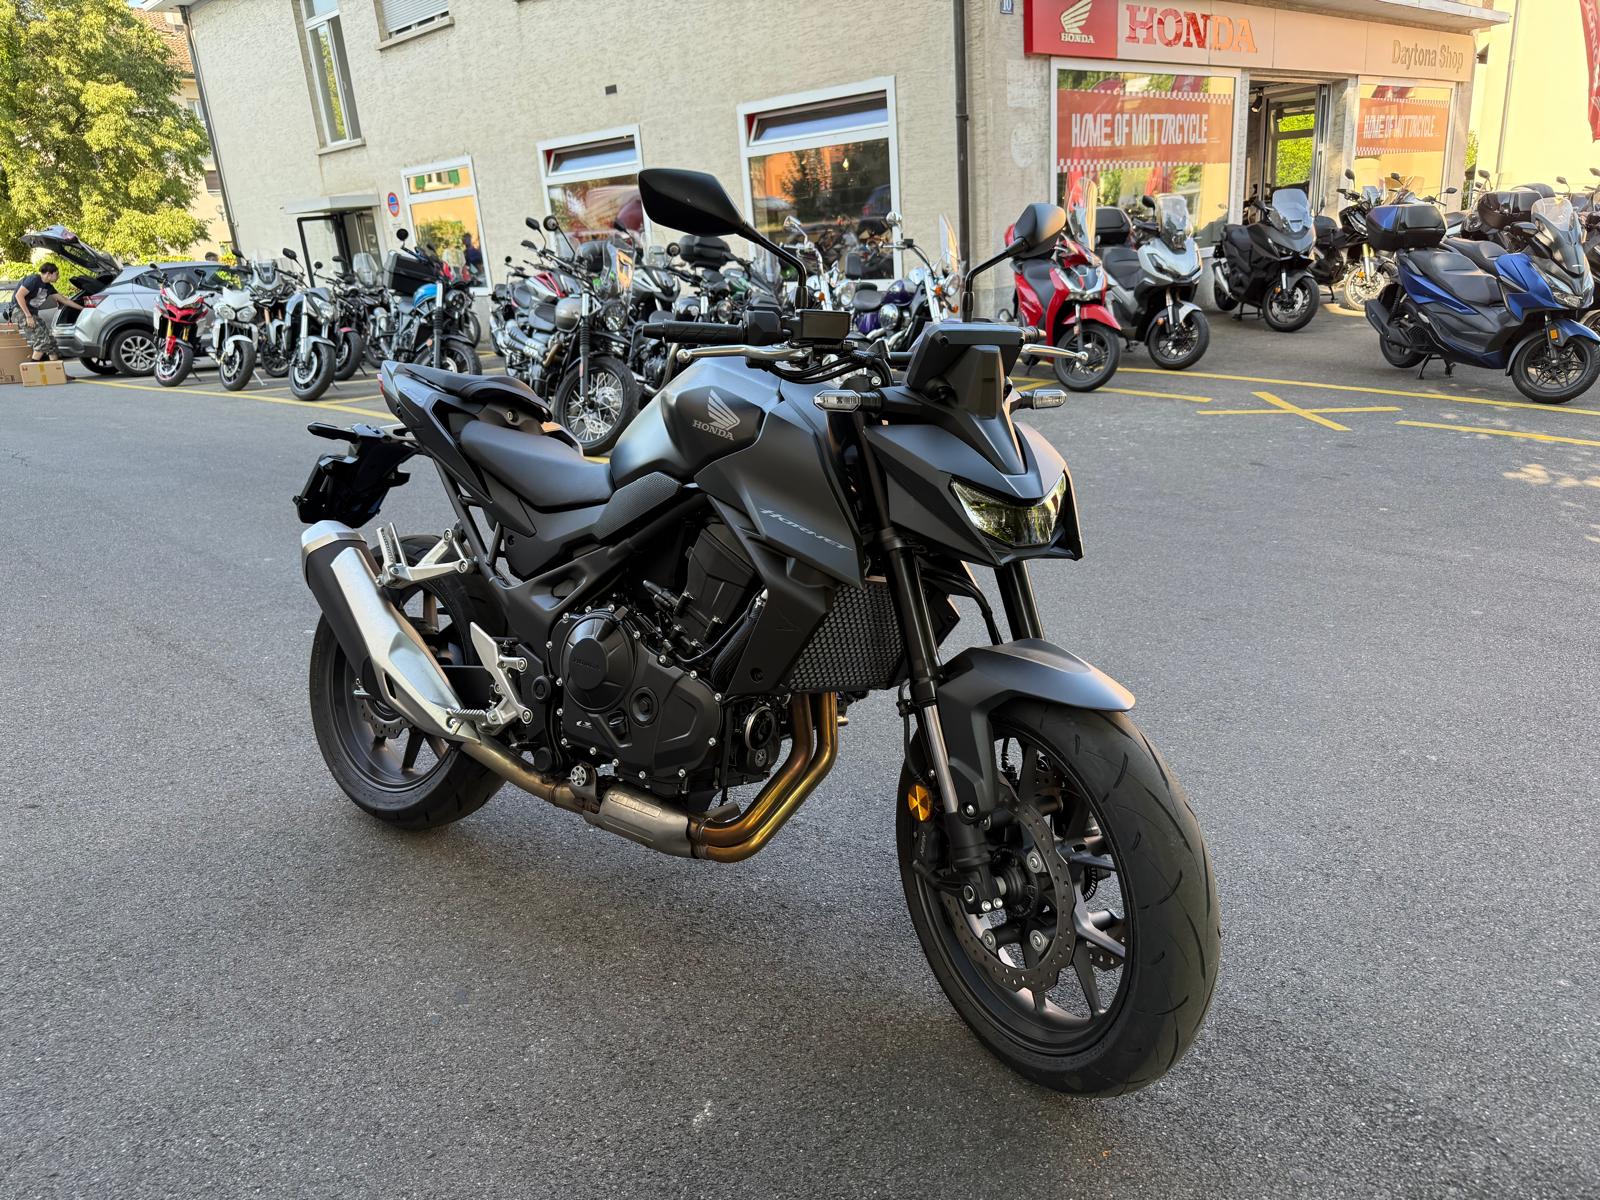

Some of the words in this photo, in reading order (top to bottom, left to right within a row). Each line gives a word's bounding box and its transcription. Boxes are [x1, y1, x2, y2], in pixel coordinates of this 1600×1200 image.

[1060, 32, 1095, 44] HONDA
[1125, 4, 1258, 54] HONDA
[1392, 39, 1437, 70] Daytona
[1440, 44, 1464, 73] Shop
[1114, 113, 1130, 148] OF
[692, 419, 735, 441] HONDA
